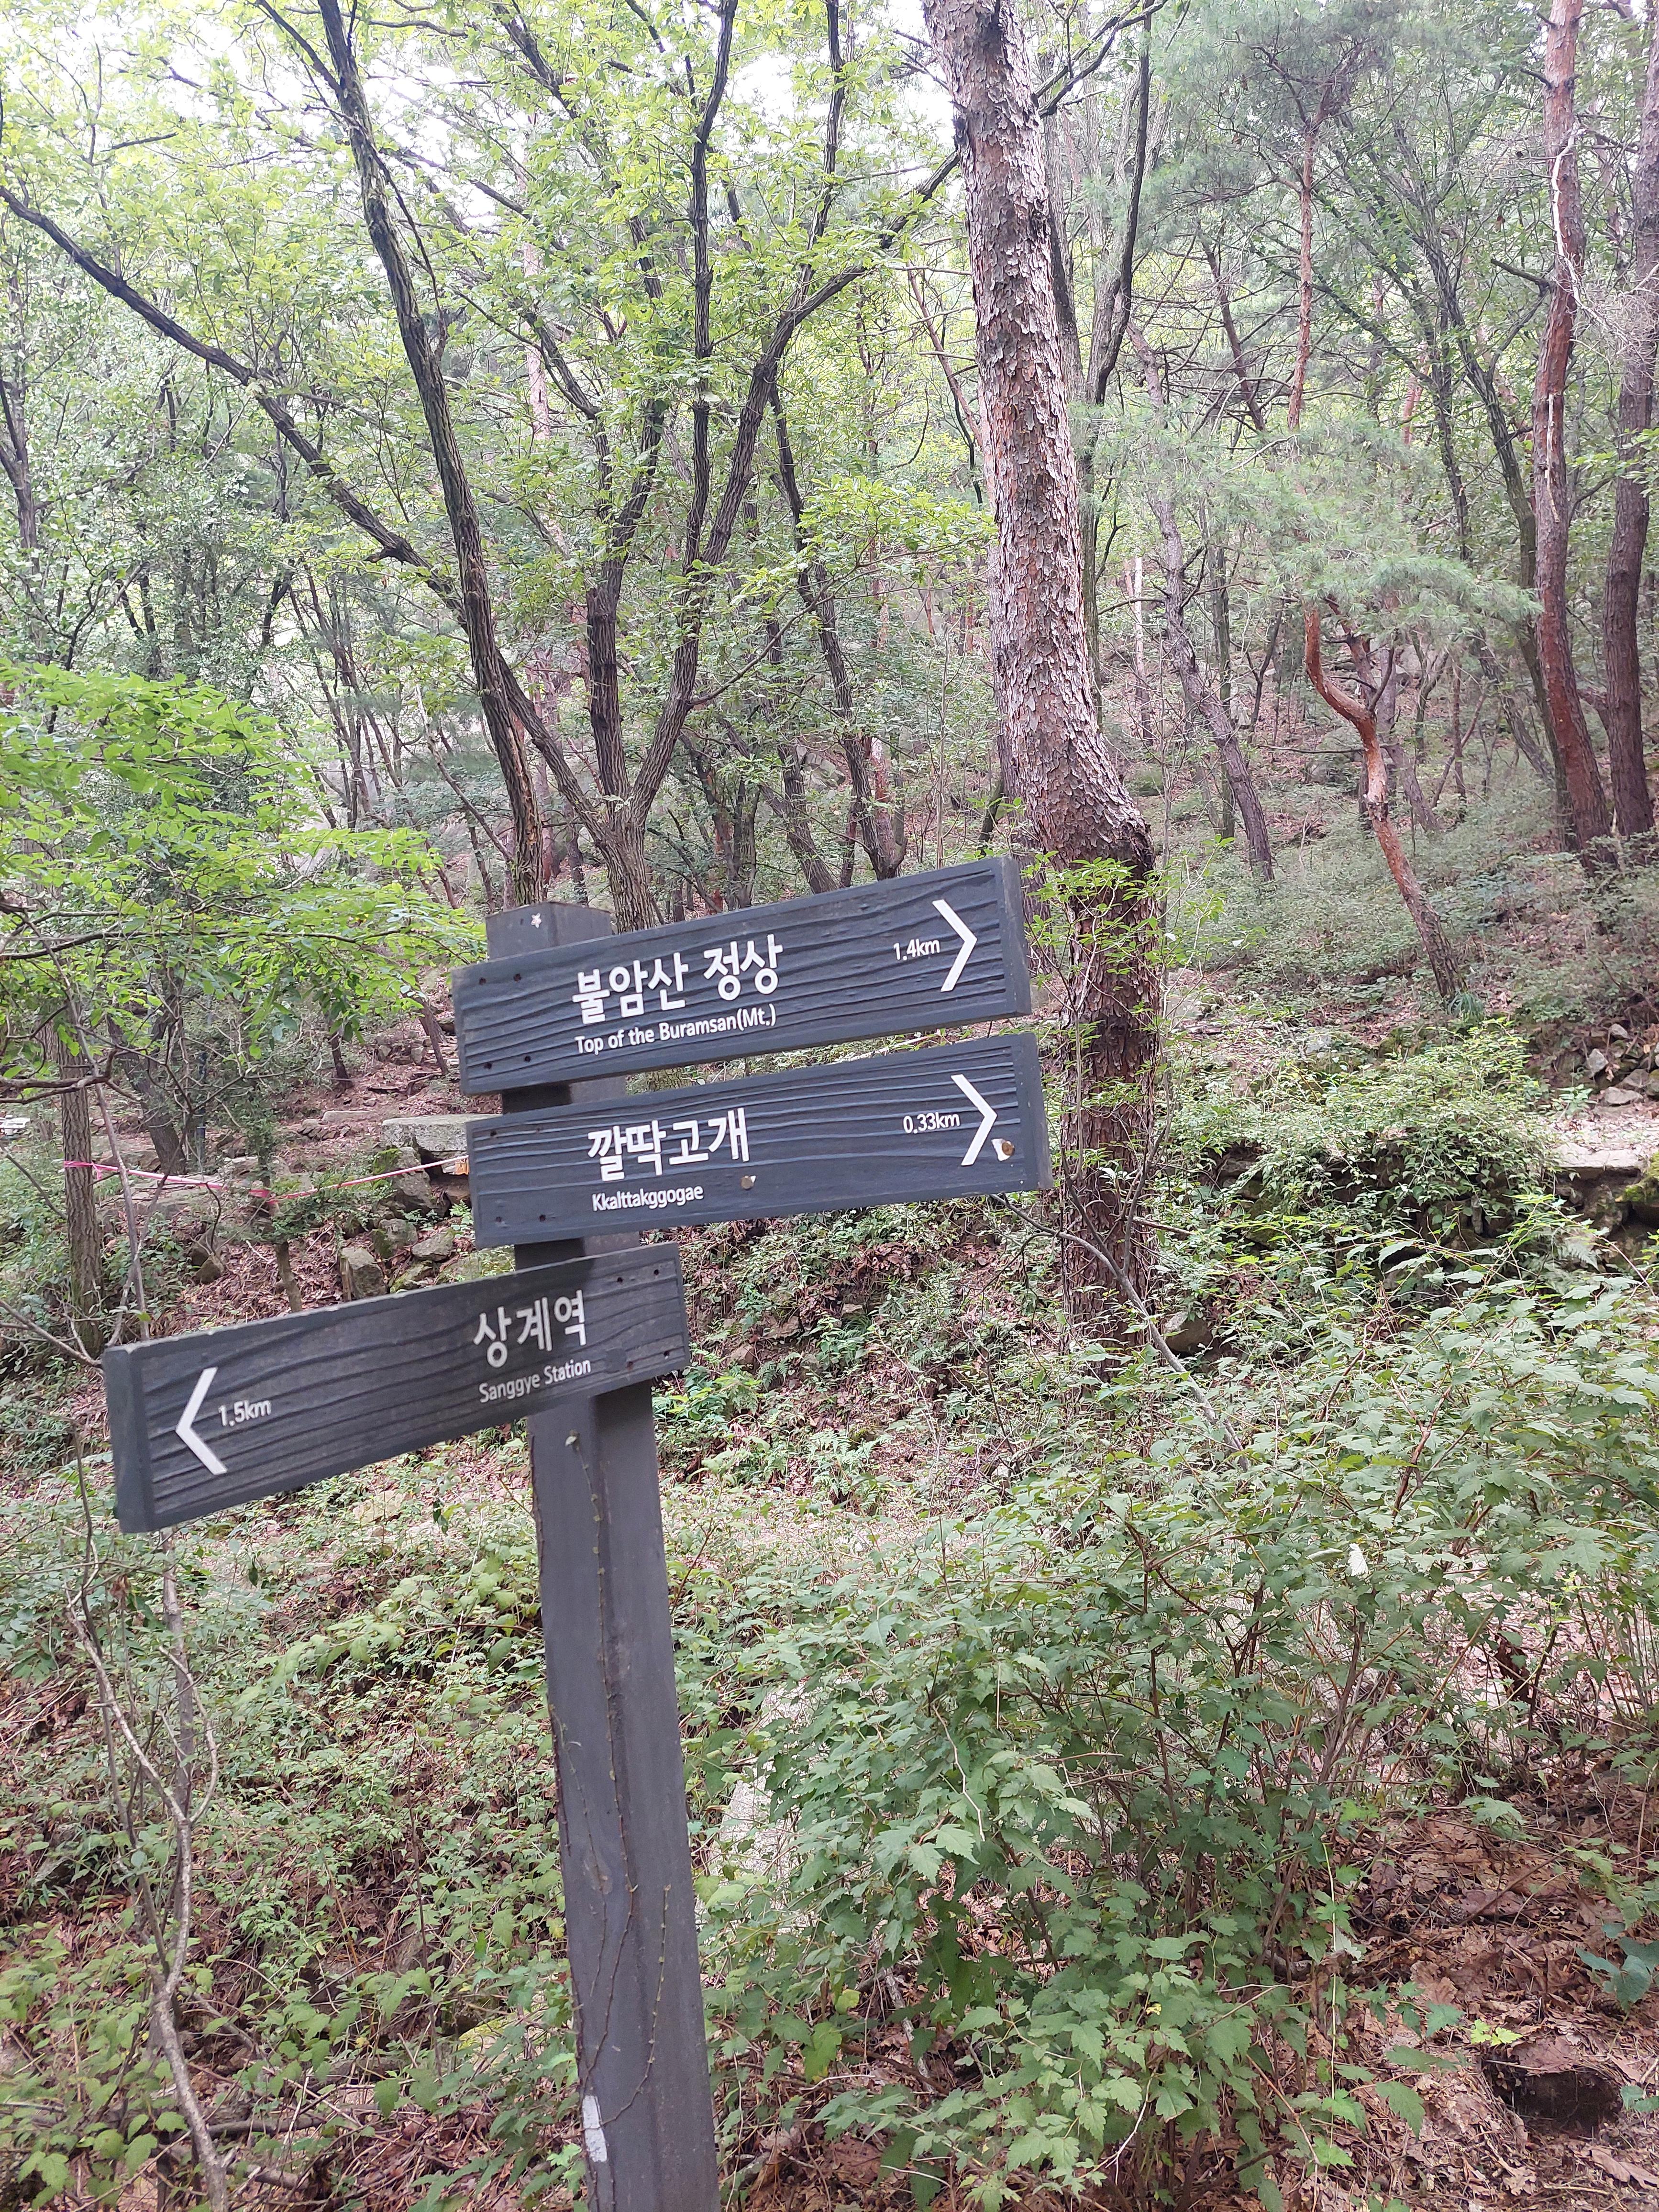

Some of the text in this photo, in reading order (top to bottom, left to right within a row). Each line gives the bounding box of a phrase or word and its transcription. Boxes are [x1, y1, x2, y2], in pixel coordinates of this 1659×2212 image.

[893, 938, 940, 961] 1.4km
[572, 934, 783, 1025] 불암산 정상
[575, 1003, 776, 1055] Top of the Buramsan(Mt.)
[587, 1107, 750, 1182] 깔딱고개
[903, 1111, 960, 1134] 0.33km
[592, 1186, 704, 1211] Kkalttakggogae
[473, 1289, 586, 1368] 상계역
[479, 1359, 592, 1403] Sanggye Station
[218, 1400, 272, 1427] 1.5km
